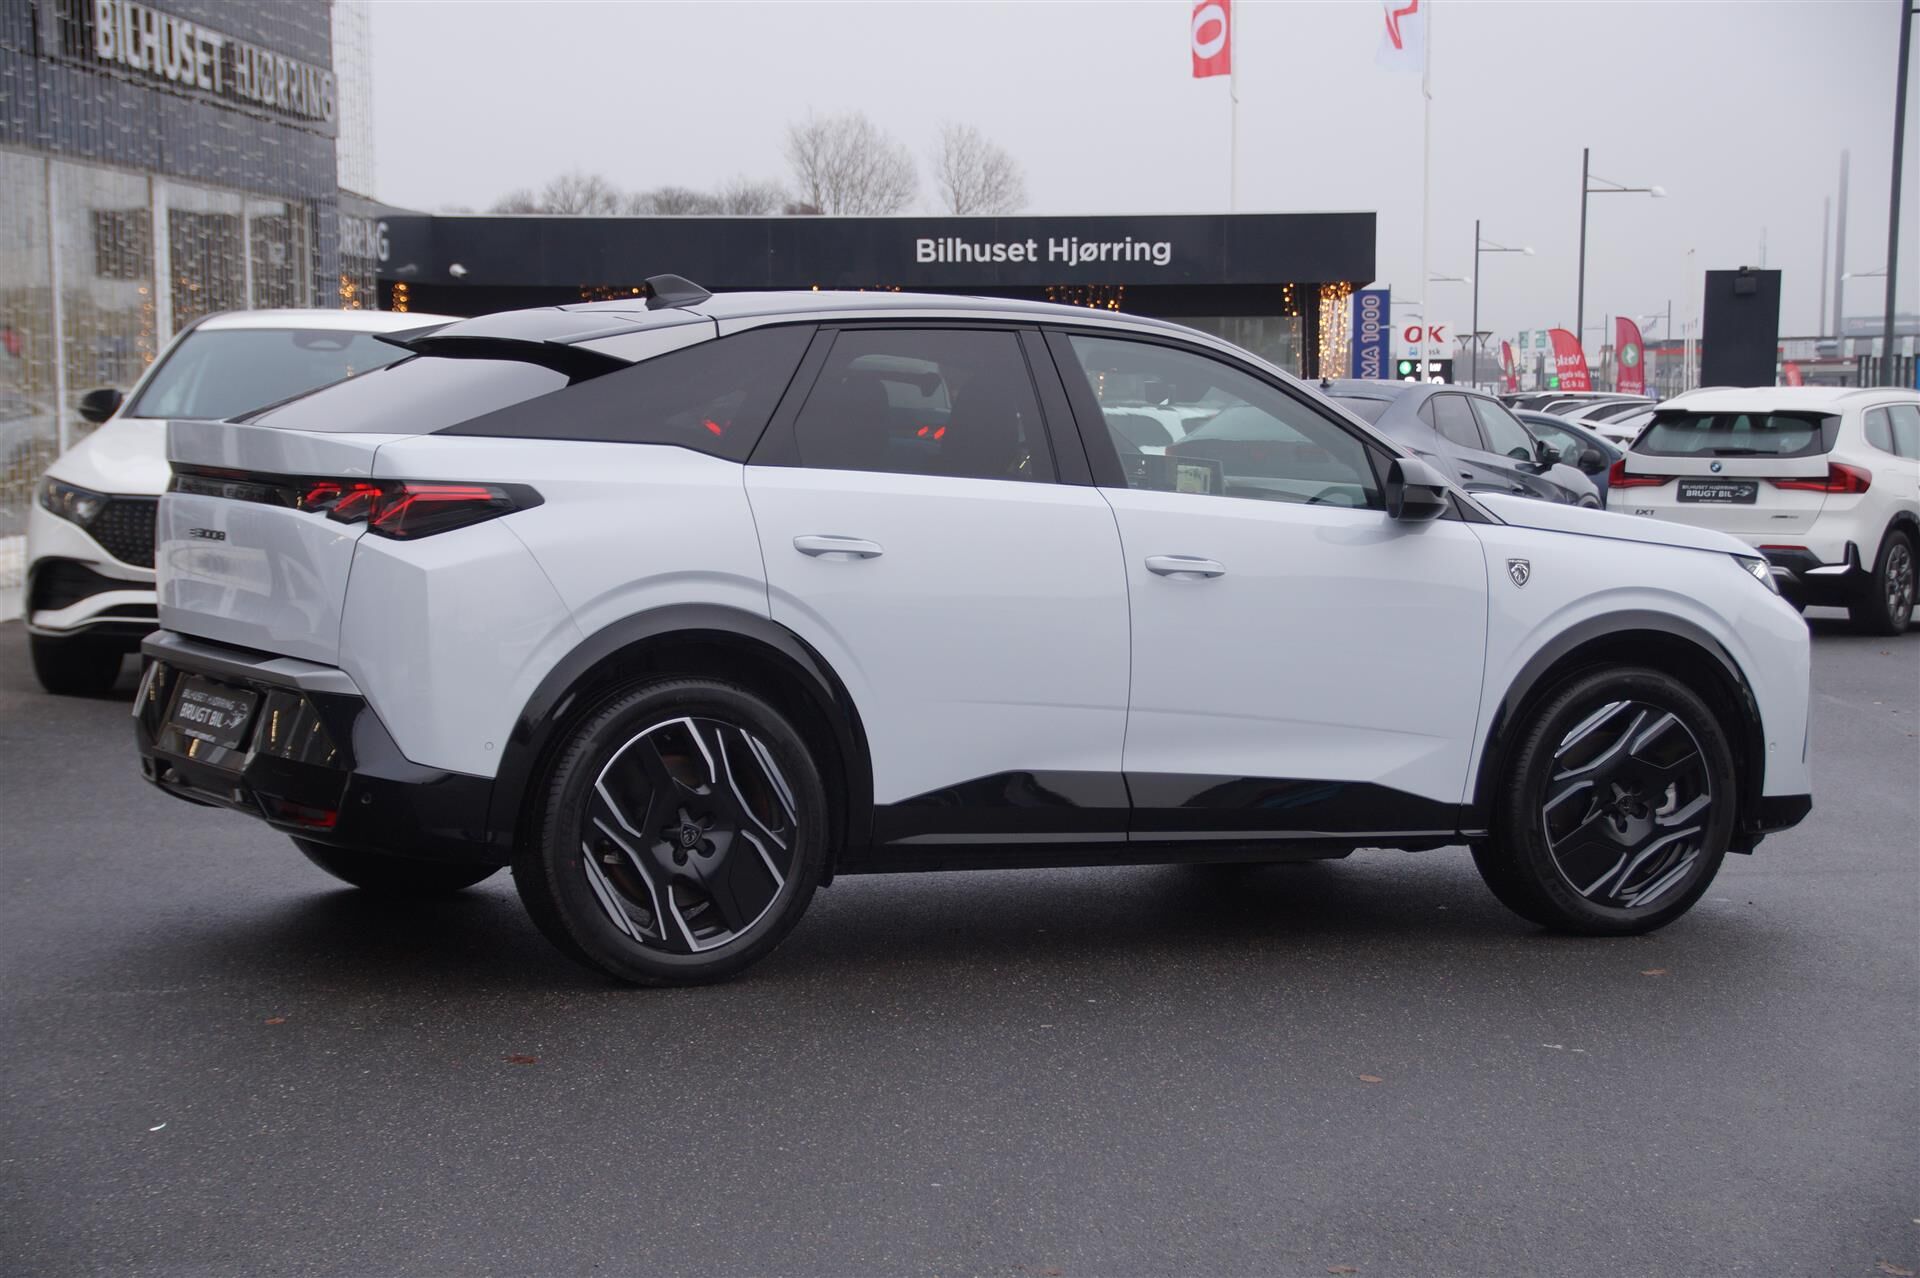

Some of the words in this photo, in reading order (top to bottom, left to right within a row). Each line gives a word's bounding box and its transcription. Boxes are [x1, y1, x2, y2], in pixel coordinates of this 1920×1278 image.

[96, 0, 225, 93] BILHUSET
[234, 42, 337, 123] HJØRRING
[916, 237, 1038, 263] Bilhuset
[1048, 236, 1171, 266] Hjørring
[1361, 295, 1380, 343] 1000
[1404, 326, 1445, 343] OK
[180, 702, 212, 723] BRUGT
[209, 710, 224, 728] BIL
